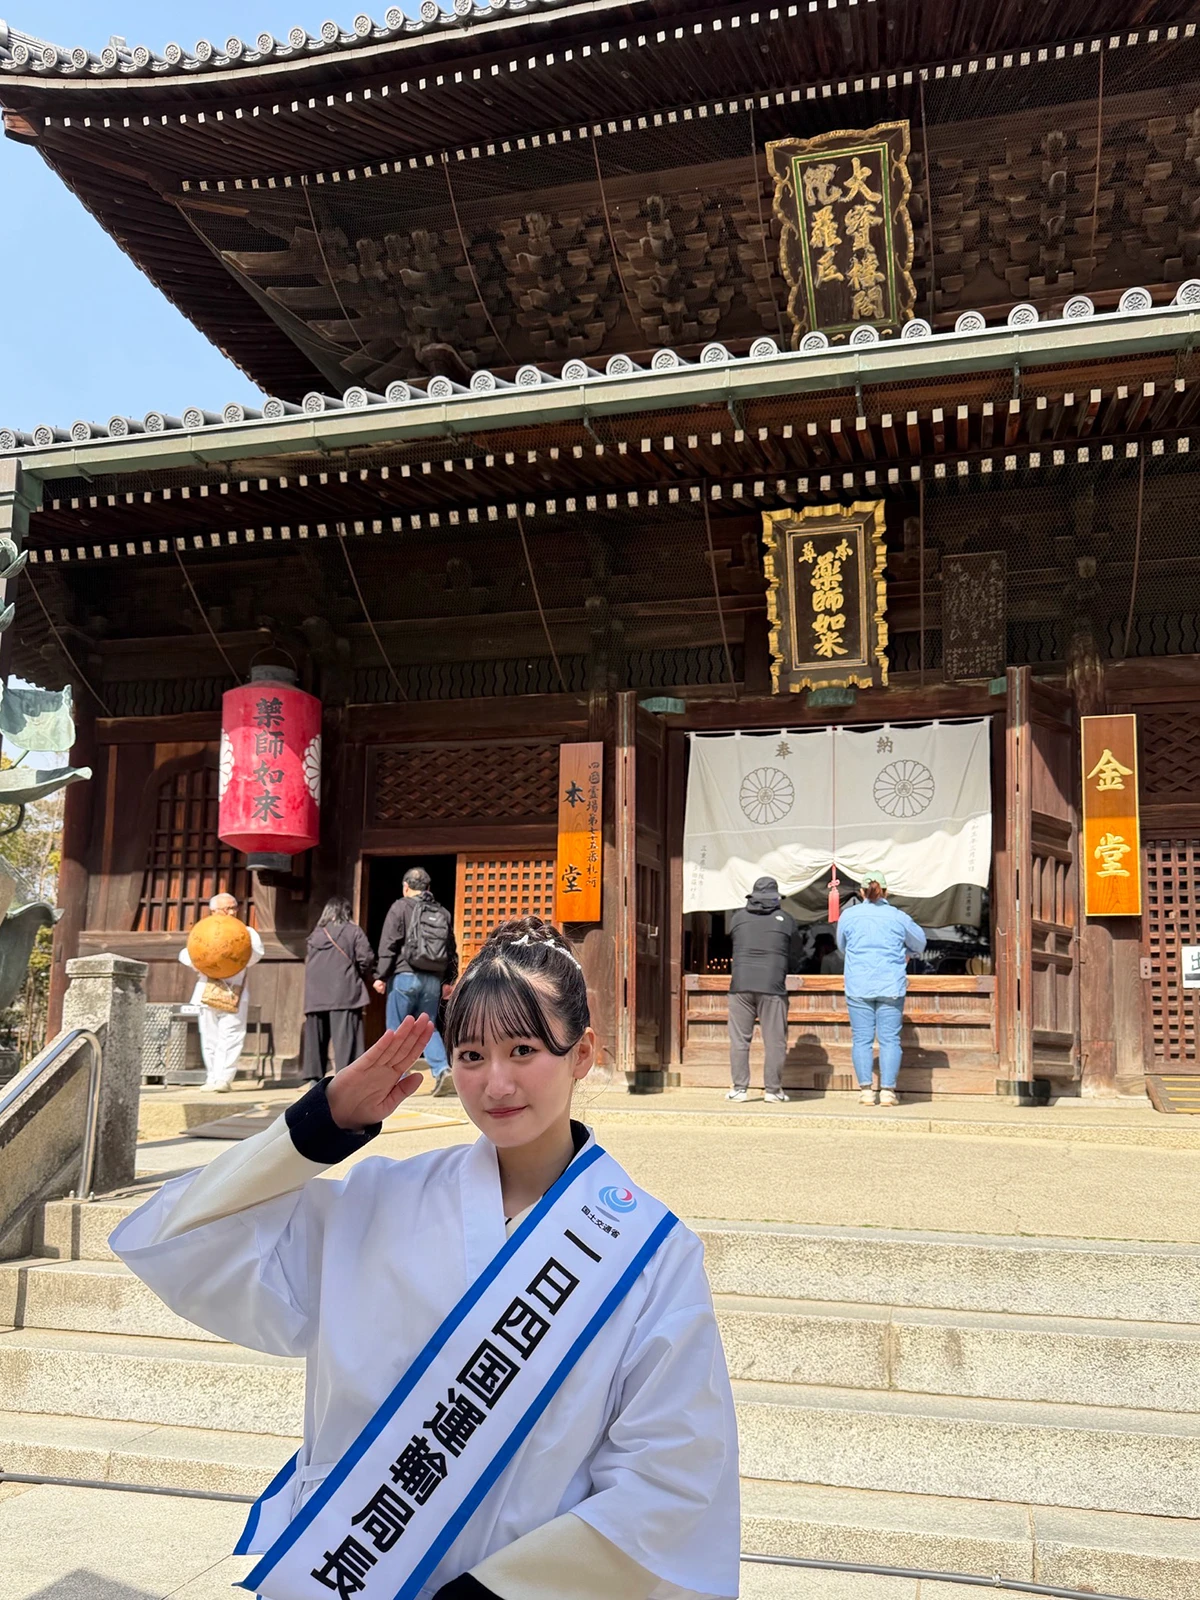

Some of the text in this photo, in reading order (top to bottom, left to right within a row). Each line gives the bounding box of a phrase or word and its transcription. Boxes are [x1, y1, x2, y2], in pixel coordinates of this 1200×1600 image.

[561, 780, 586, 893] 本堂
[1087, 748, 1134, 878] 金堂
[581, 1205, 620, 1238] 国土交通省
[310, 1228, 603, 1600] 一日四国運輸局長
